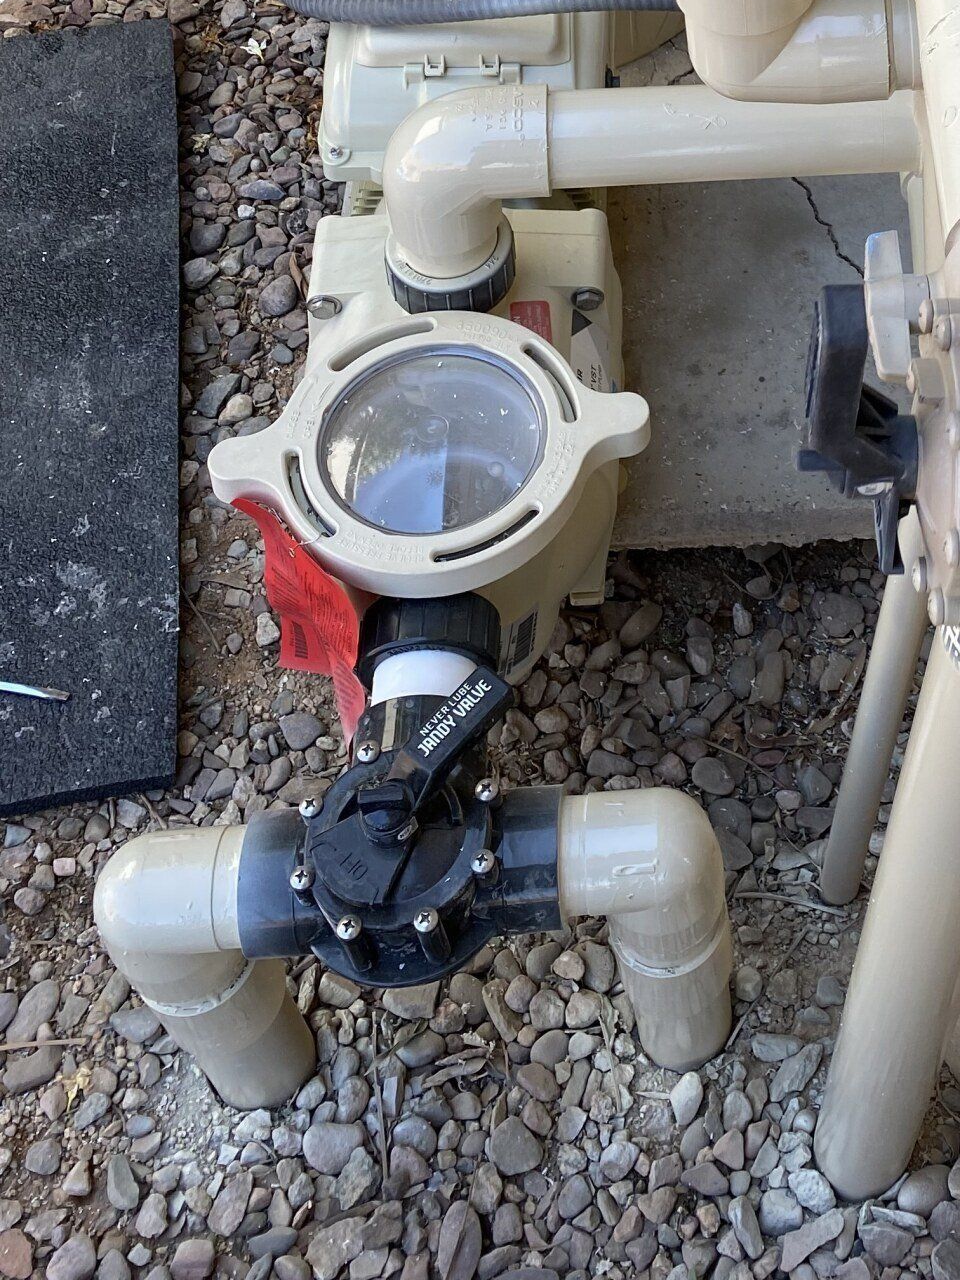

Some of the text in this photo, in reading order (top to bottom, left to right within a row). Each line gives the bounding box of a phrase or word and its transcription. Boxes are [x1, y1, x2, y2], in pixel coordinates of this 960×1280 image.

[417, 679, 492, 758] JANDY VALVE
[419, 682, 473, 737] NEVER LUBE
